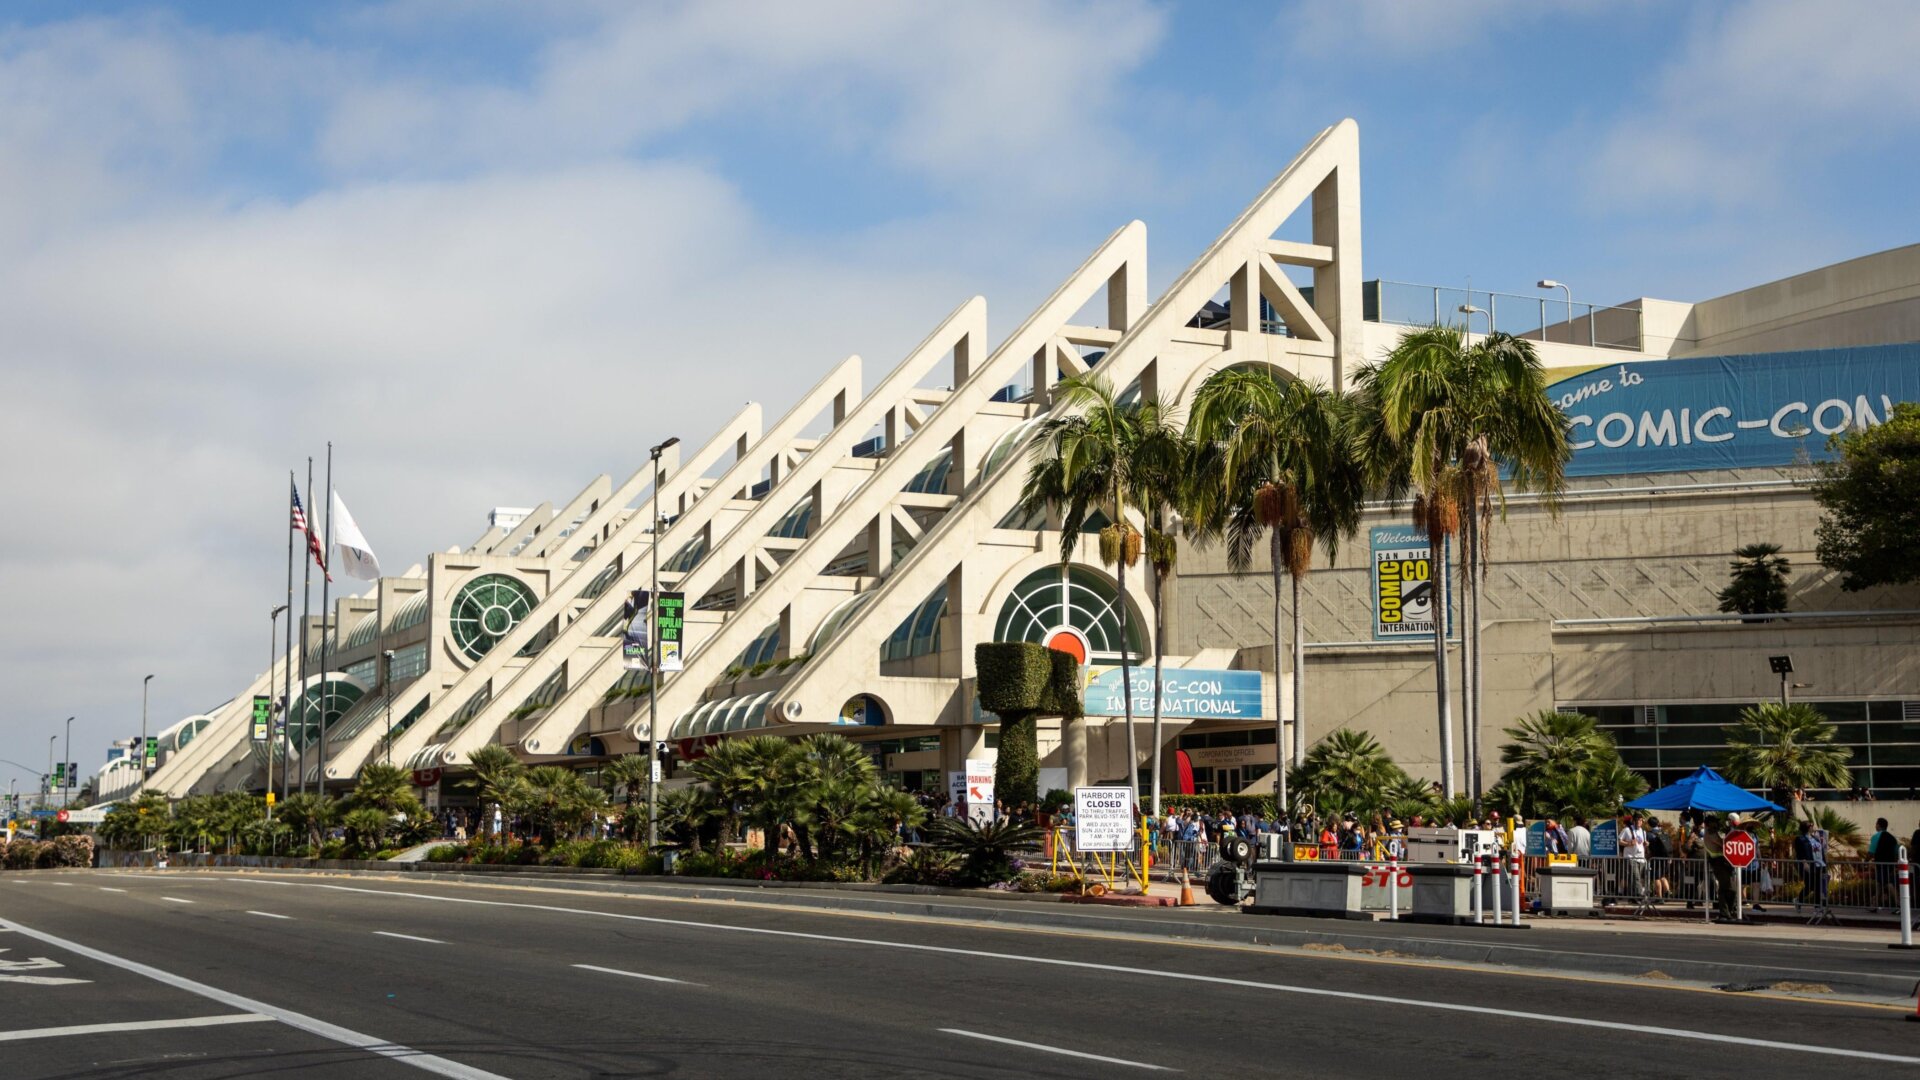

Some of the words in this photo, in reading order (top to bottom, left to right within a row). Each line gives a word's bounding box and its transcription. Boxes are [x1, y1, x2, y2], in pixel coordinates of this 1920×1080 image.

[1619, 364, 1644, 388] to
[1565, 394, 1894, 450] COMIC-CON
[1375, 532, 1430, 544] Welcome
[1378, 552, 1399, 561] SAN
[1408, 551, 1428, 559] DIE
[1401, 559, 1429, 581] CO
[1379, 560, 1402, 623] COMIC
[666, 607, 675, 617] THE
[658, 617, 683, 628] POPULAR
[1380, 622, 1435, 633] INTERNATION
[662, 628, 677, 640] ARTS
[968, 775, 992, 784] PARKING
[1086, 800, 1122, 808] CLOSED
[1725, 840, 1754, 856] STOP
[1361, 871, 1414, 888] STO
